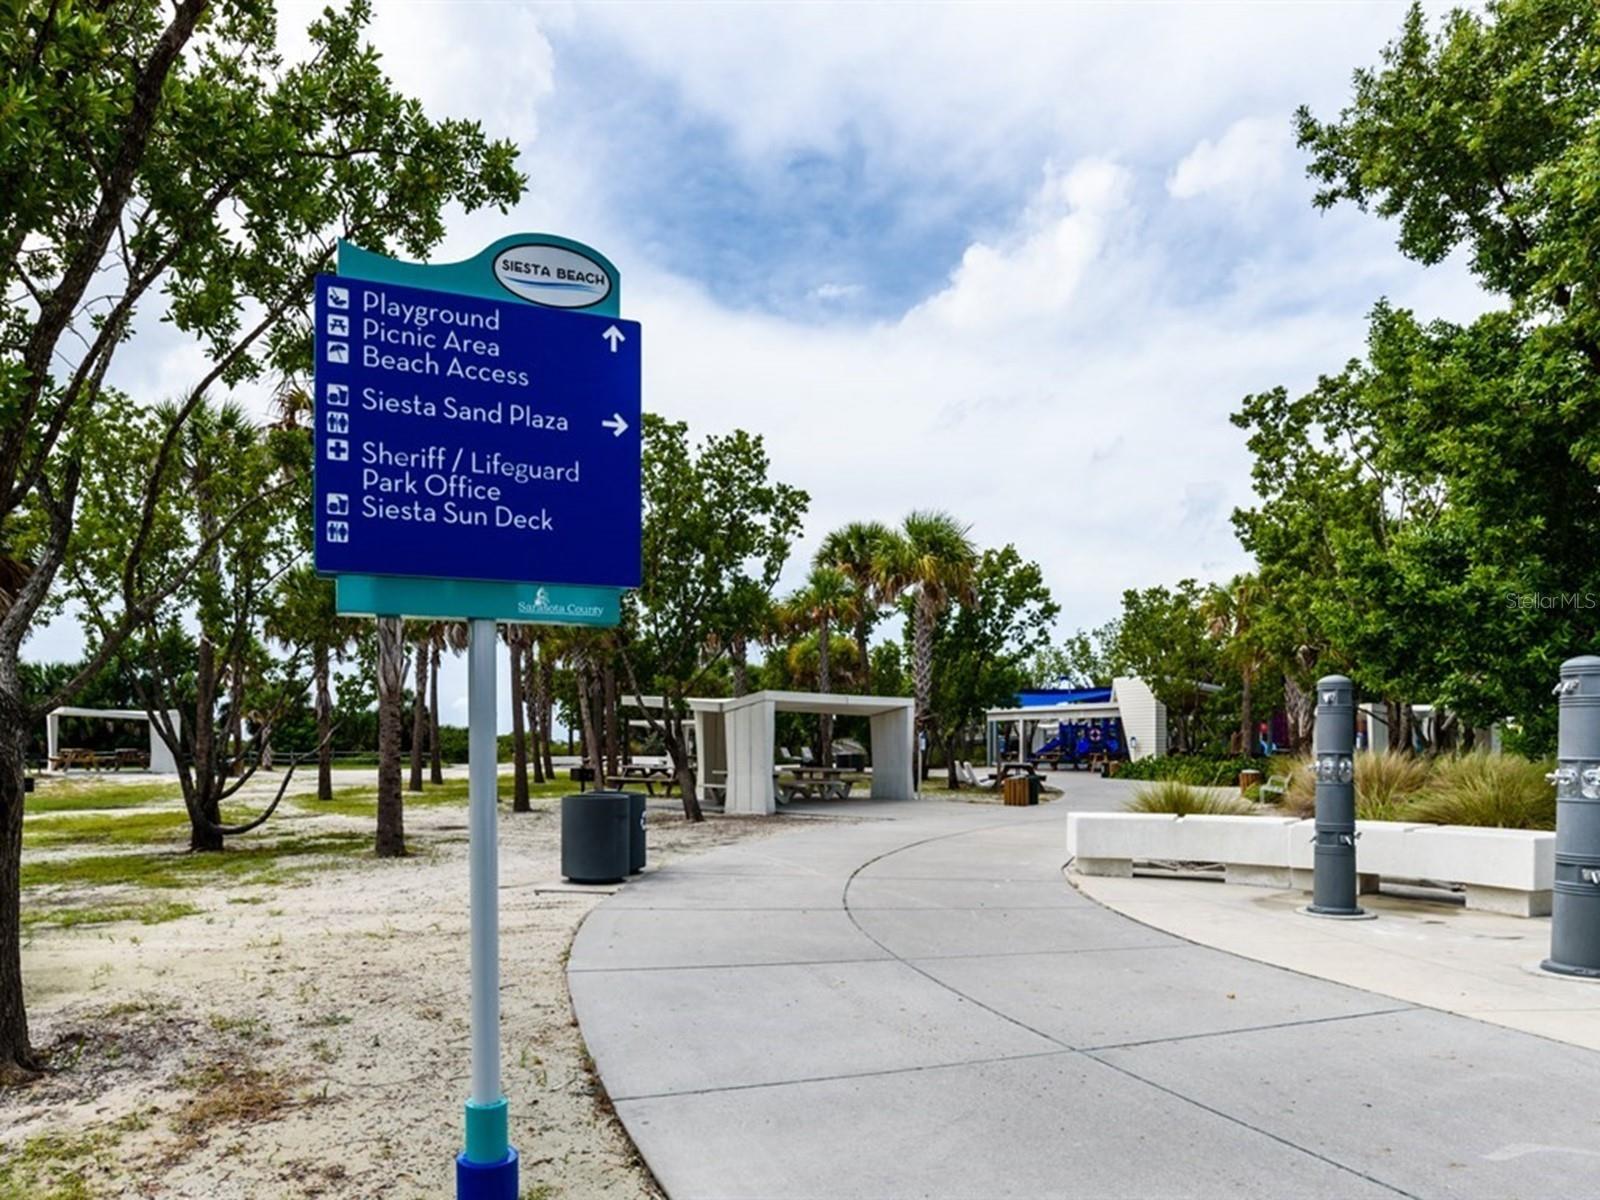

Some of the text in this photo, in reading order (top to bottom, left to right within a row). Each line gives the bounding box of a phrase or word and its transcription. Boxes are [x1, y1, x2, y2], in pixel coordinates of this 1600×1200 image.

[502, 258, 606, 286] SIESTA BEACH
[363, 290, 501, 331] Playground
[363, 318, 501, 358] Picnic Area
[363, 345, 530, 387] Beach Access
[361, 388, 569, 432] Siesta Sand Plaza
[361, 441, 580, 484] Sheriff / Lifeguard
[363, 469, 502, 501] Park Office
[361, 496, 554, 531] Siesta Sun Deck
[566, 603, 604, 617] County
